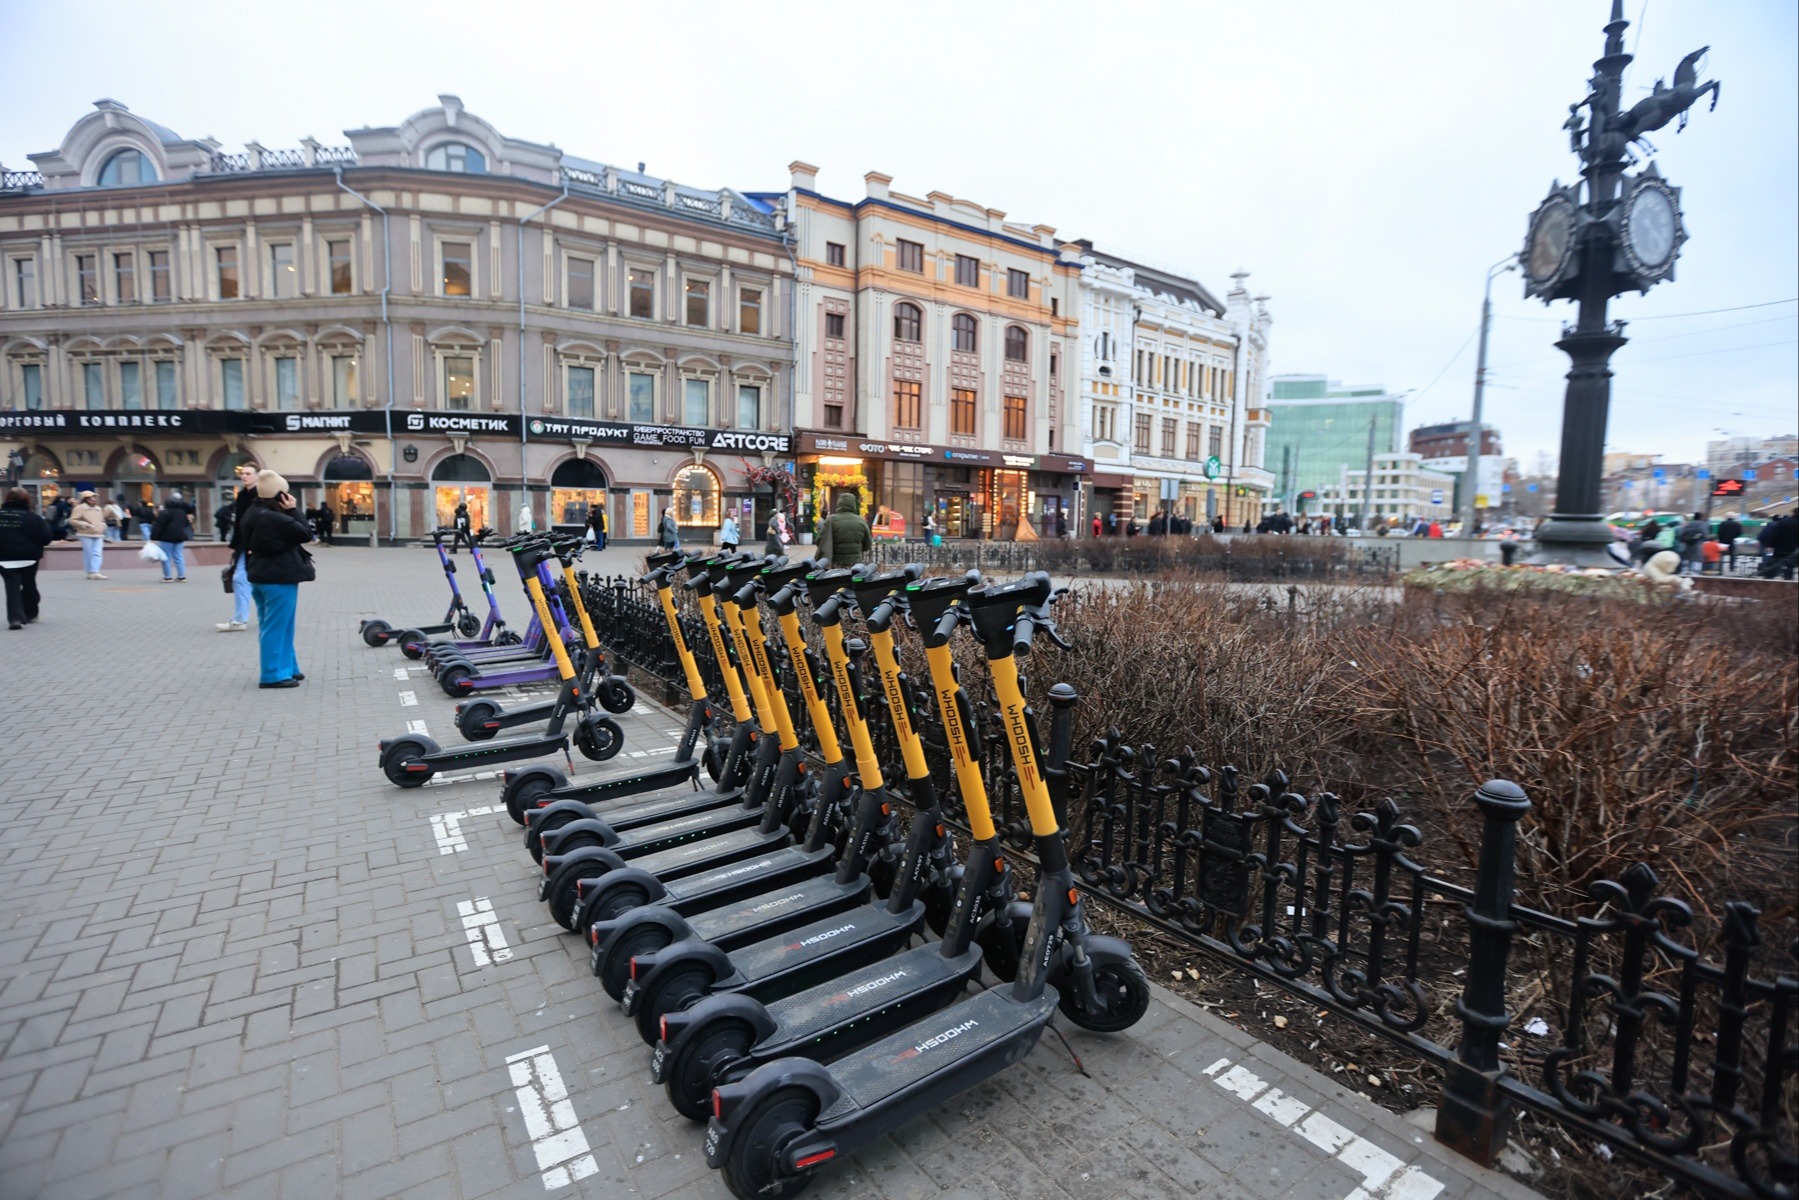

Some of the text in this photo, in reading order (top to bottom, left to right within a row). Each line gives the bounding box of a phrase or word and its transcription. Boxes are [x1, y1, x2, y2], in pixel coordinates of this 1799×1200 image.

[80, 415, 183, 427] КОМПЛЕКС
[302, 416, 351, 428] МАГНИТ
[429, 416, 509, 431] КОСМЕТИК
[572, 424, 628, 438] ПРОДУКТ
[633, 425, 705, 437] КИБЕРПРОСТРАНСТВО
[689, 437, 705, 445] FUN
[711, 432, 789, 451] ARTCORE
[859, 443, 885, 453] ФОТО
[709, 622, 725, 659] WHOOSH
[733, 628, 751, 667] WHOOSH
[752, 638, 770, 680] WHOOSH
[792, 646, 812, 690] WHOOSH
[834, 661, 853, 707] WHOOSH
[885, 670, 905, 721] WHOOSH
[941, 689, 963, 745] WHOOSH
[1007, 704, 1032, 765] WHOOSH
[752, 893, 804, 913] WHOOSH
[969, 895, 982, 924] AC3035
[800, 924, 856, 947] WHOOSH
[1043, 934, 1055, 967] AE0729
[847, 970, 907, 998] WHOOSH
[915, 1019, 979, 1053] WHOOSH
